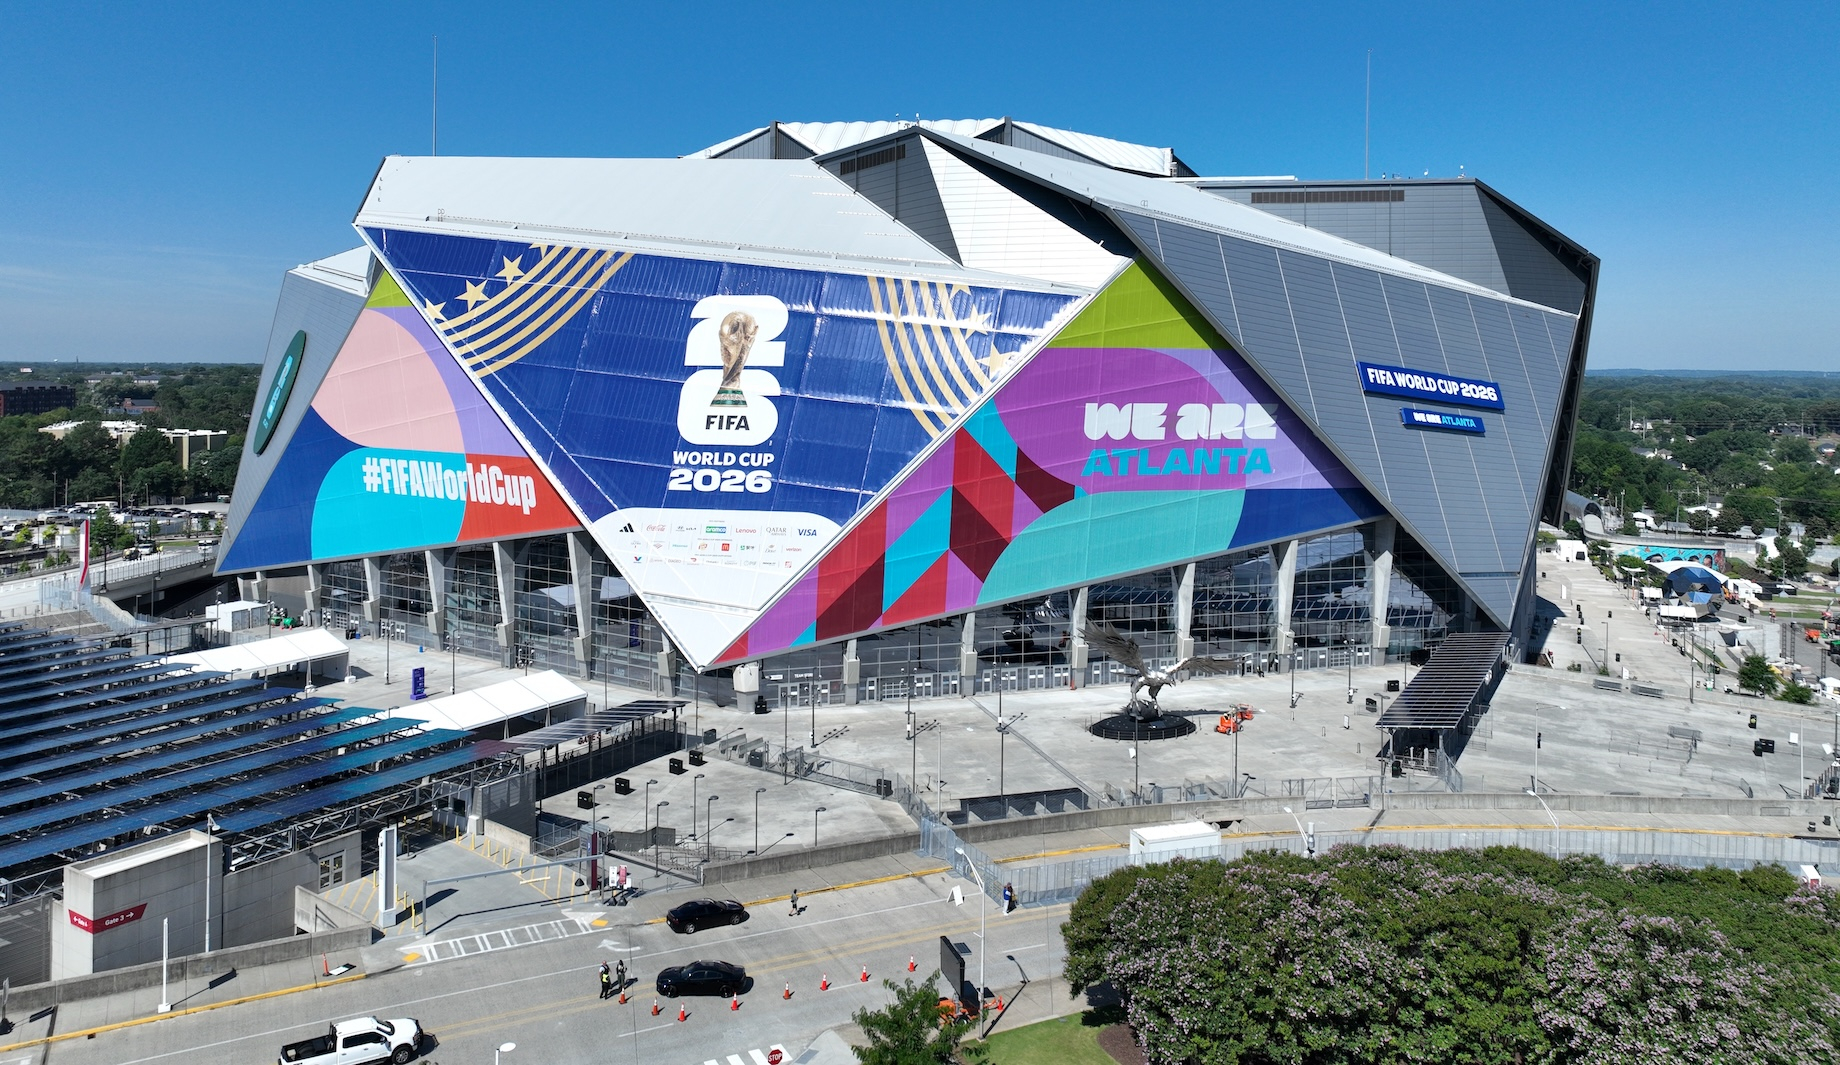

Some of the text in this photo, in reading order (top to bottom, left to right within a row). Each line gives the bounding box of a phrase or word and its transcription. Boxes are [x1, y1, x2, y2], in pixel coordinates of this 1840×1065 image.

[1366, 367, 1498, 402] FIFA WORLD CUP 2026
[705, 415, 750, 431] FIFA
[1084, 402, 1169, 440] WE
[1413, 411, 1427, 423] WE
[1441, 415, 1476, 428] ATLANTA
[673, 450, 775, 467] WORLD CUP
[1081, 447, 1273, 477] ATLANTA
[362, 456, 537, 515] #FIFAWorldCup
[668, 469, 773, 493] 2026
[798, 528, 817, 537] VISA
[105, 917, 119, 926] Gate
[769, 1053, 782, 1062] STOP
